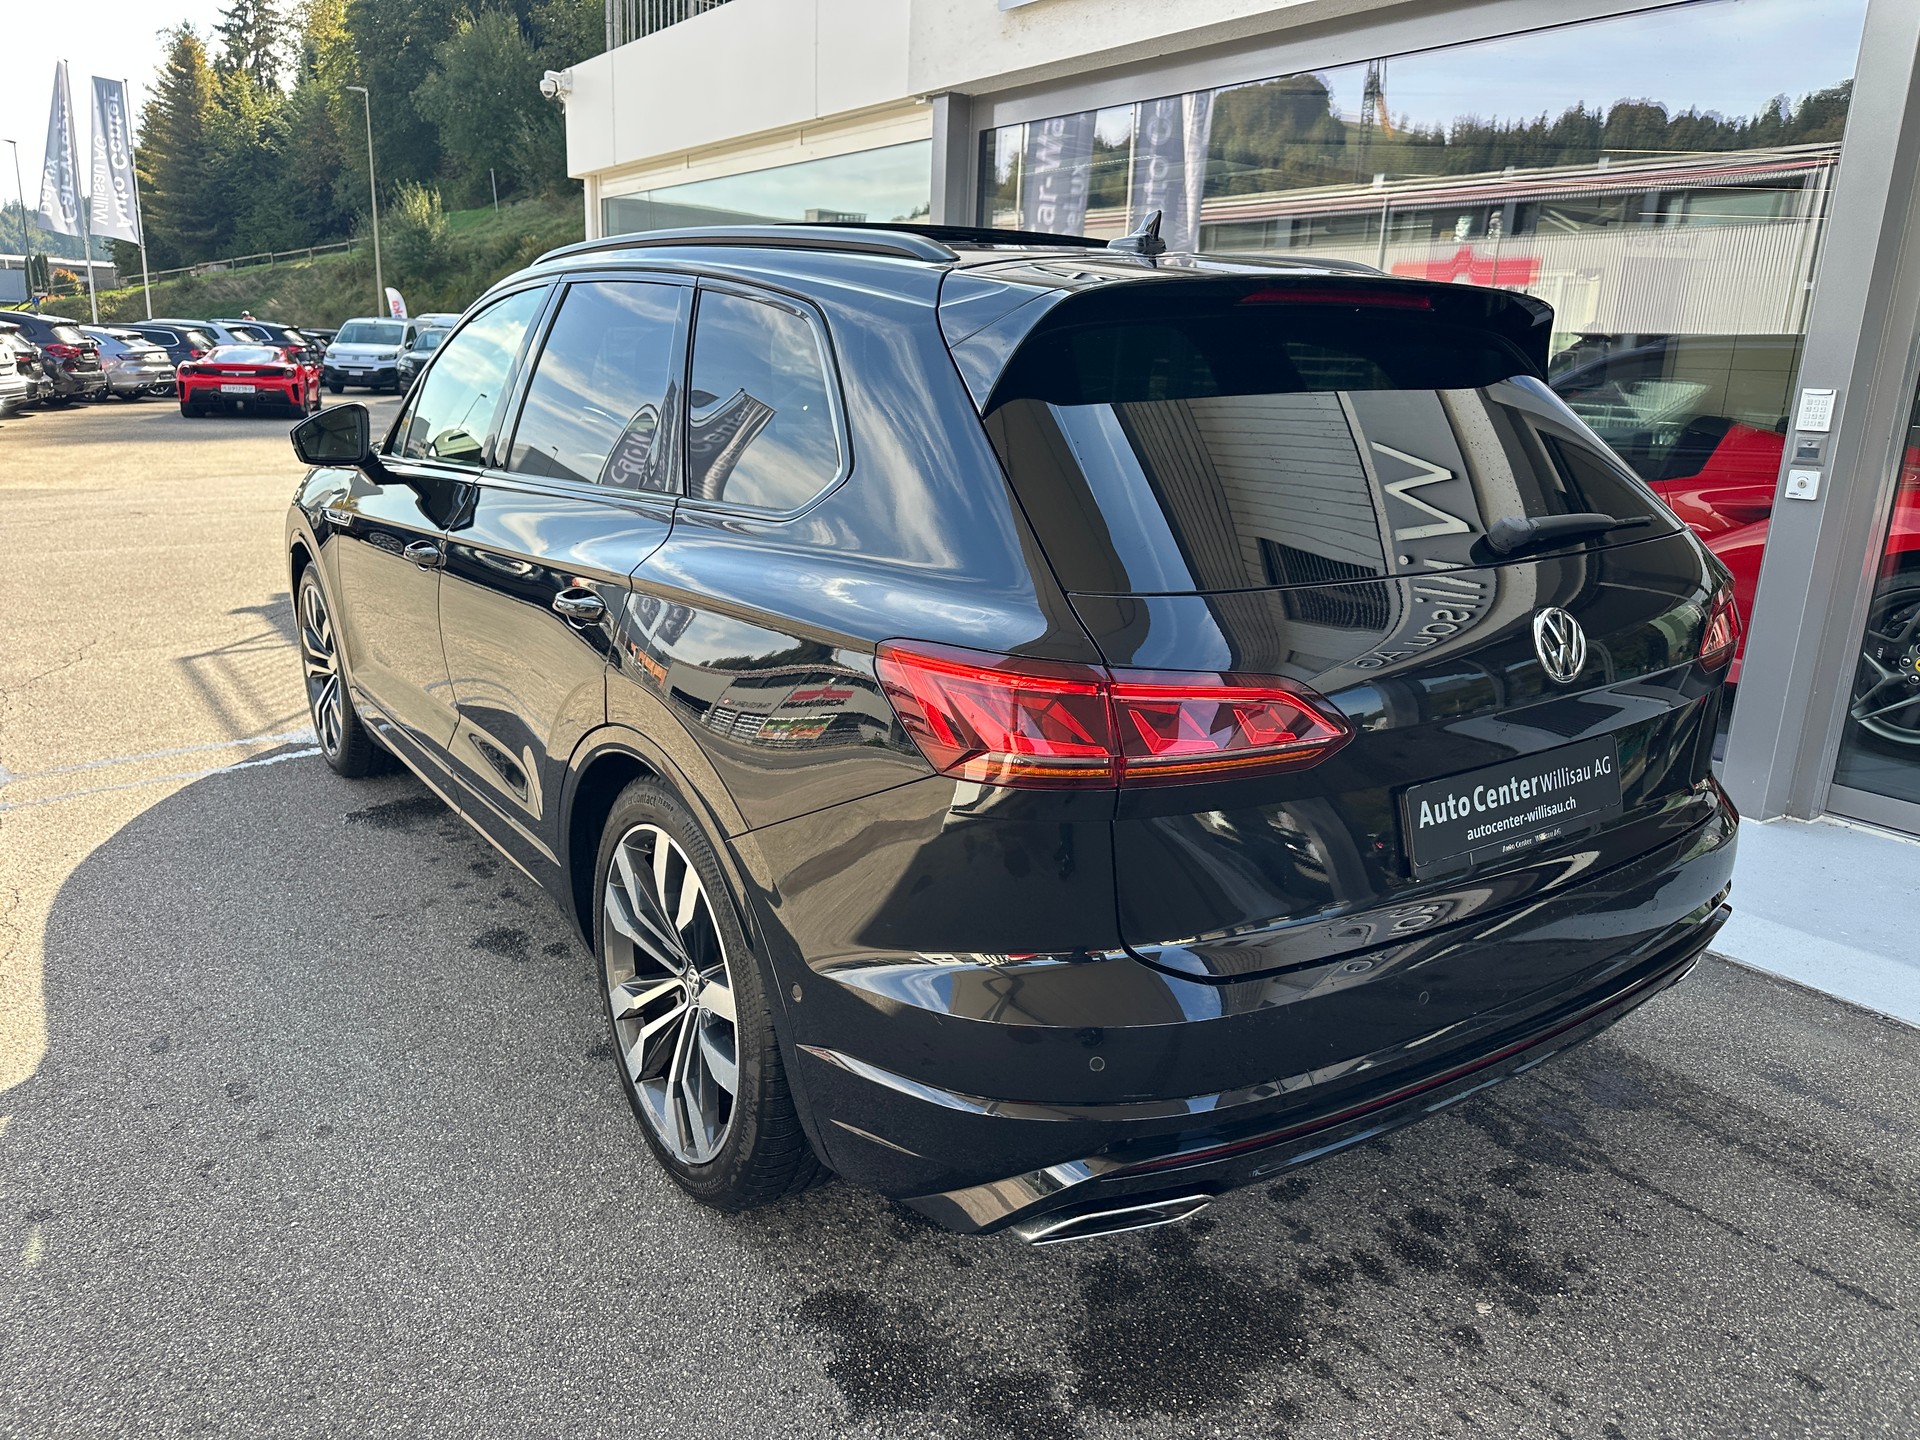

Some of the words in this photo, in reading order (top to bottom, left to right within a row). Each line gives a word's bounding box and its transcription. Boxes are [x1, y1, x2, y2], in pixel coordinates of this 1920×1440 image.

[1419, 793, 1471, 829] Auto
[1473, 776, 1539, 812] Center
[1539, 765, 1591, 792] Willisau
[1594, 755, 1611, 777] AG
[1467, 796, 1577, 841] autocenter-willisau.ch
